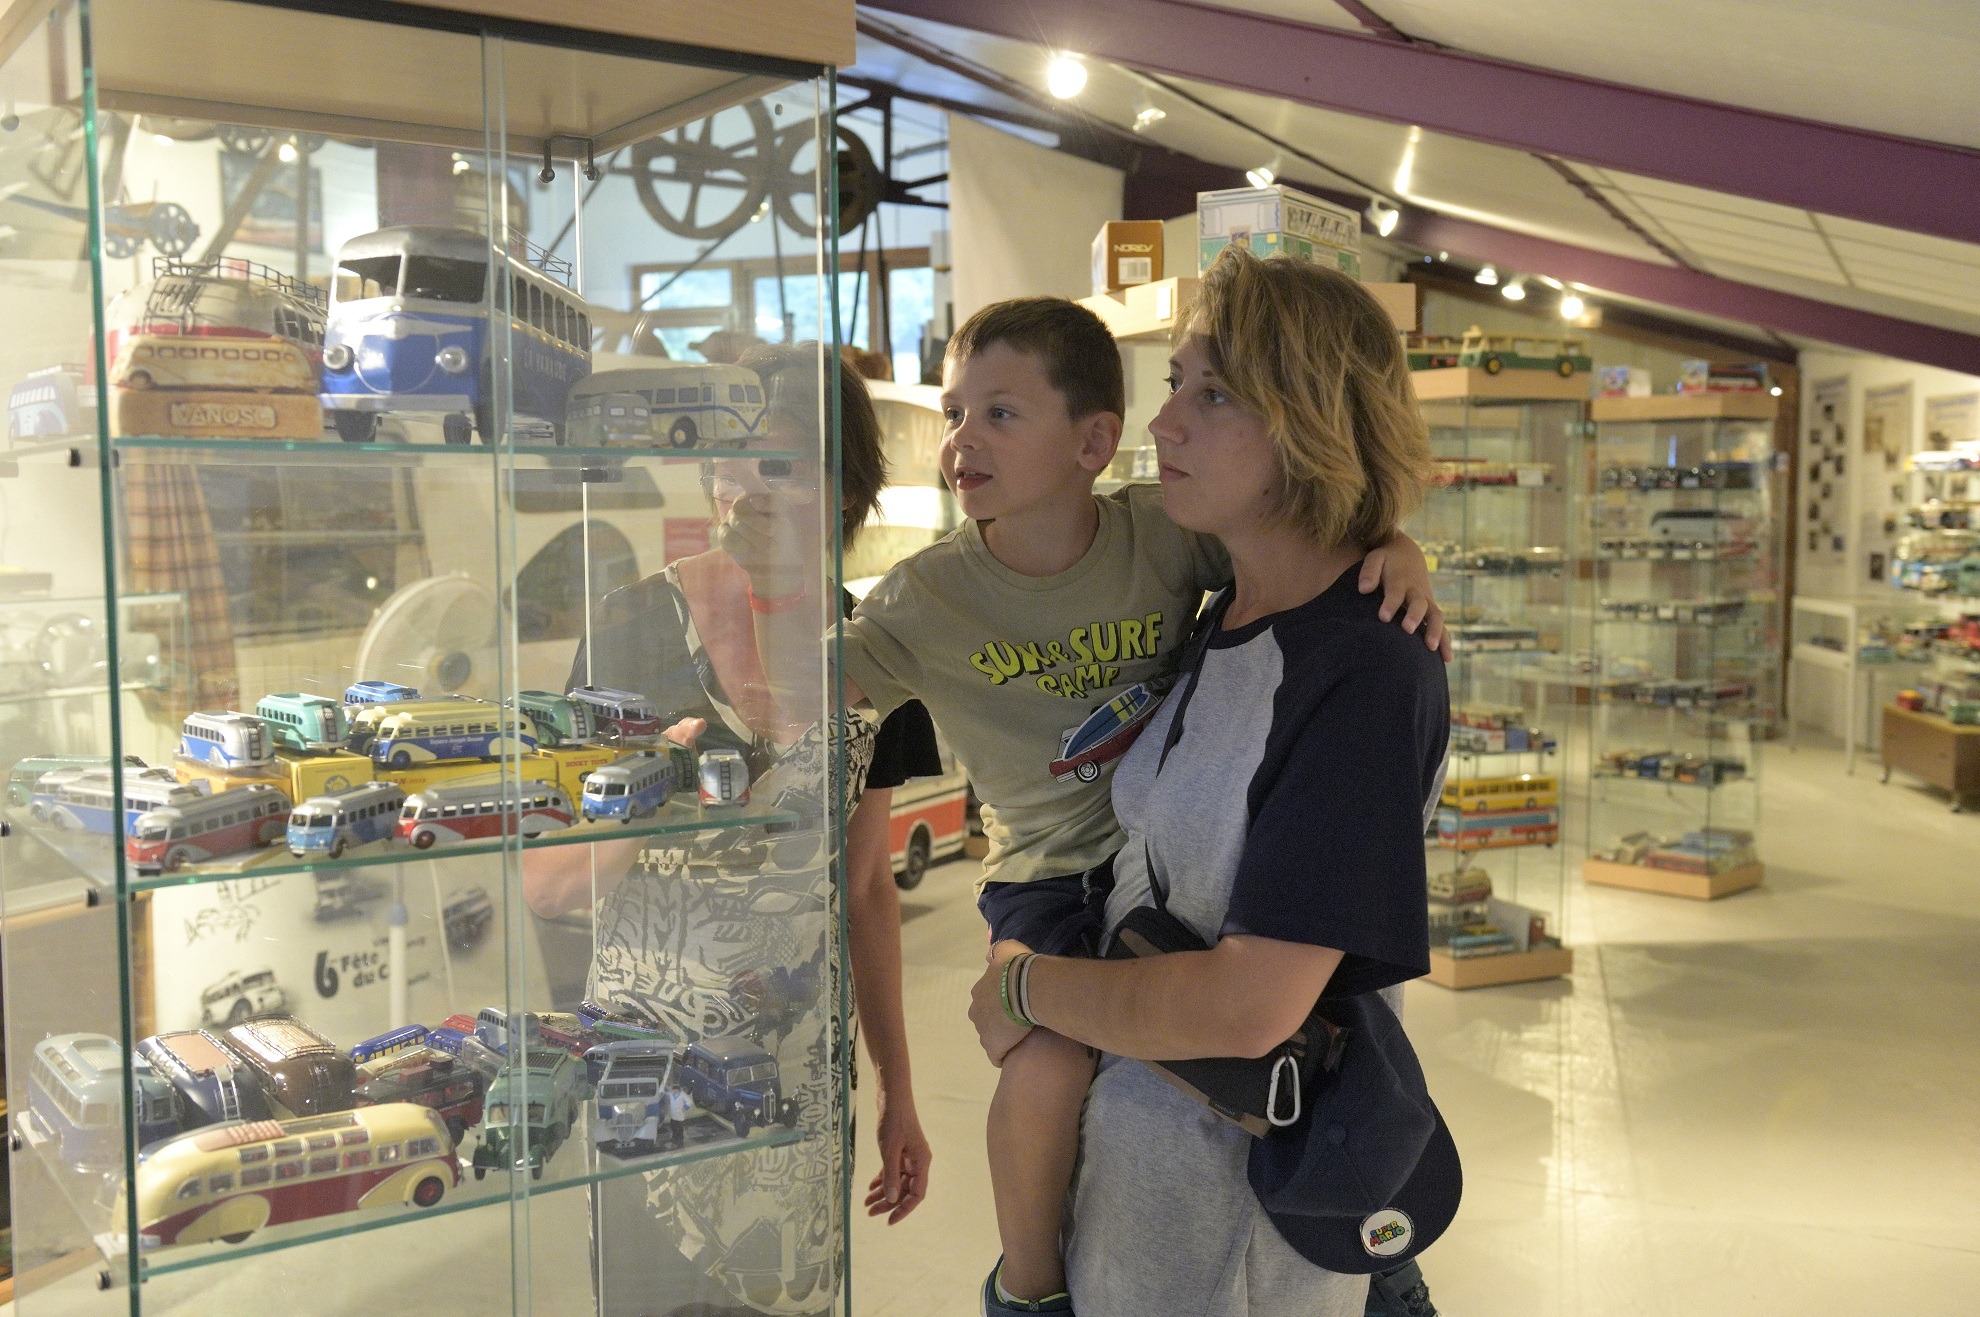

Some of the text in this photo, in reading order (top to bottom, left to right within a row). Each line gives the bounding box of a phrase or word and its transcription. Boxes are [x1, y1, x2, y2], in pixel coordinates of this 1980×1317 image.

[1113, 243, 1154, 253] NOREV
[968, 640, 1052, 685] SUN
[1068, 611, 1164, 664] SURF
[1035, 663, 1120, 699] CAMP
[1370, 1225, 1406, 1248] MARIO
